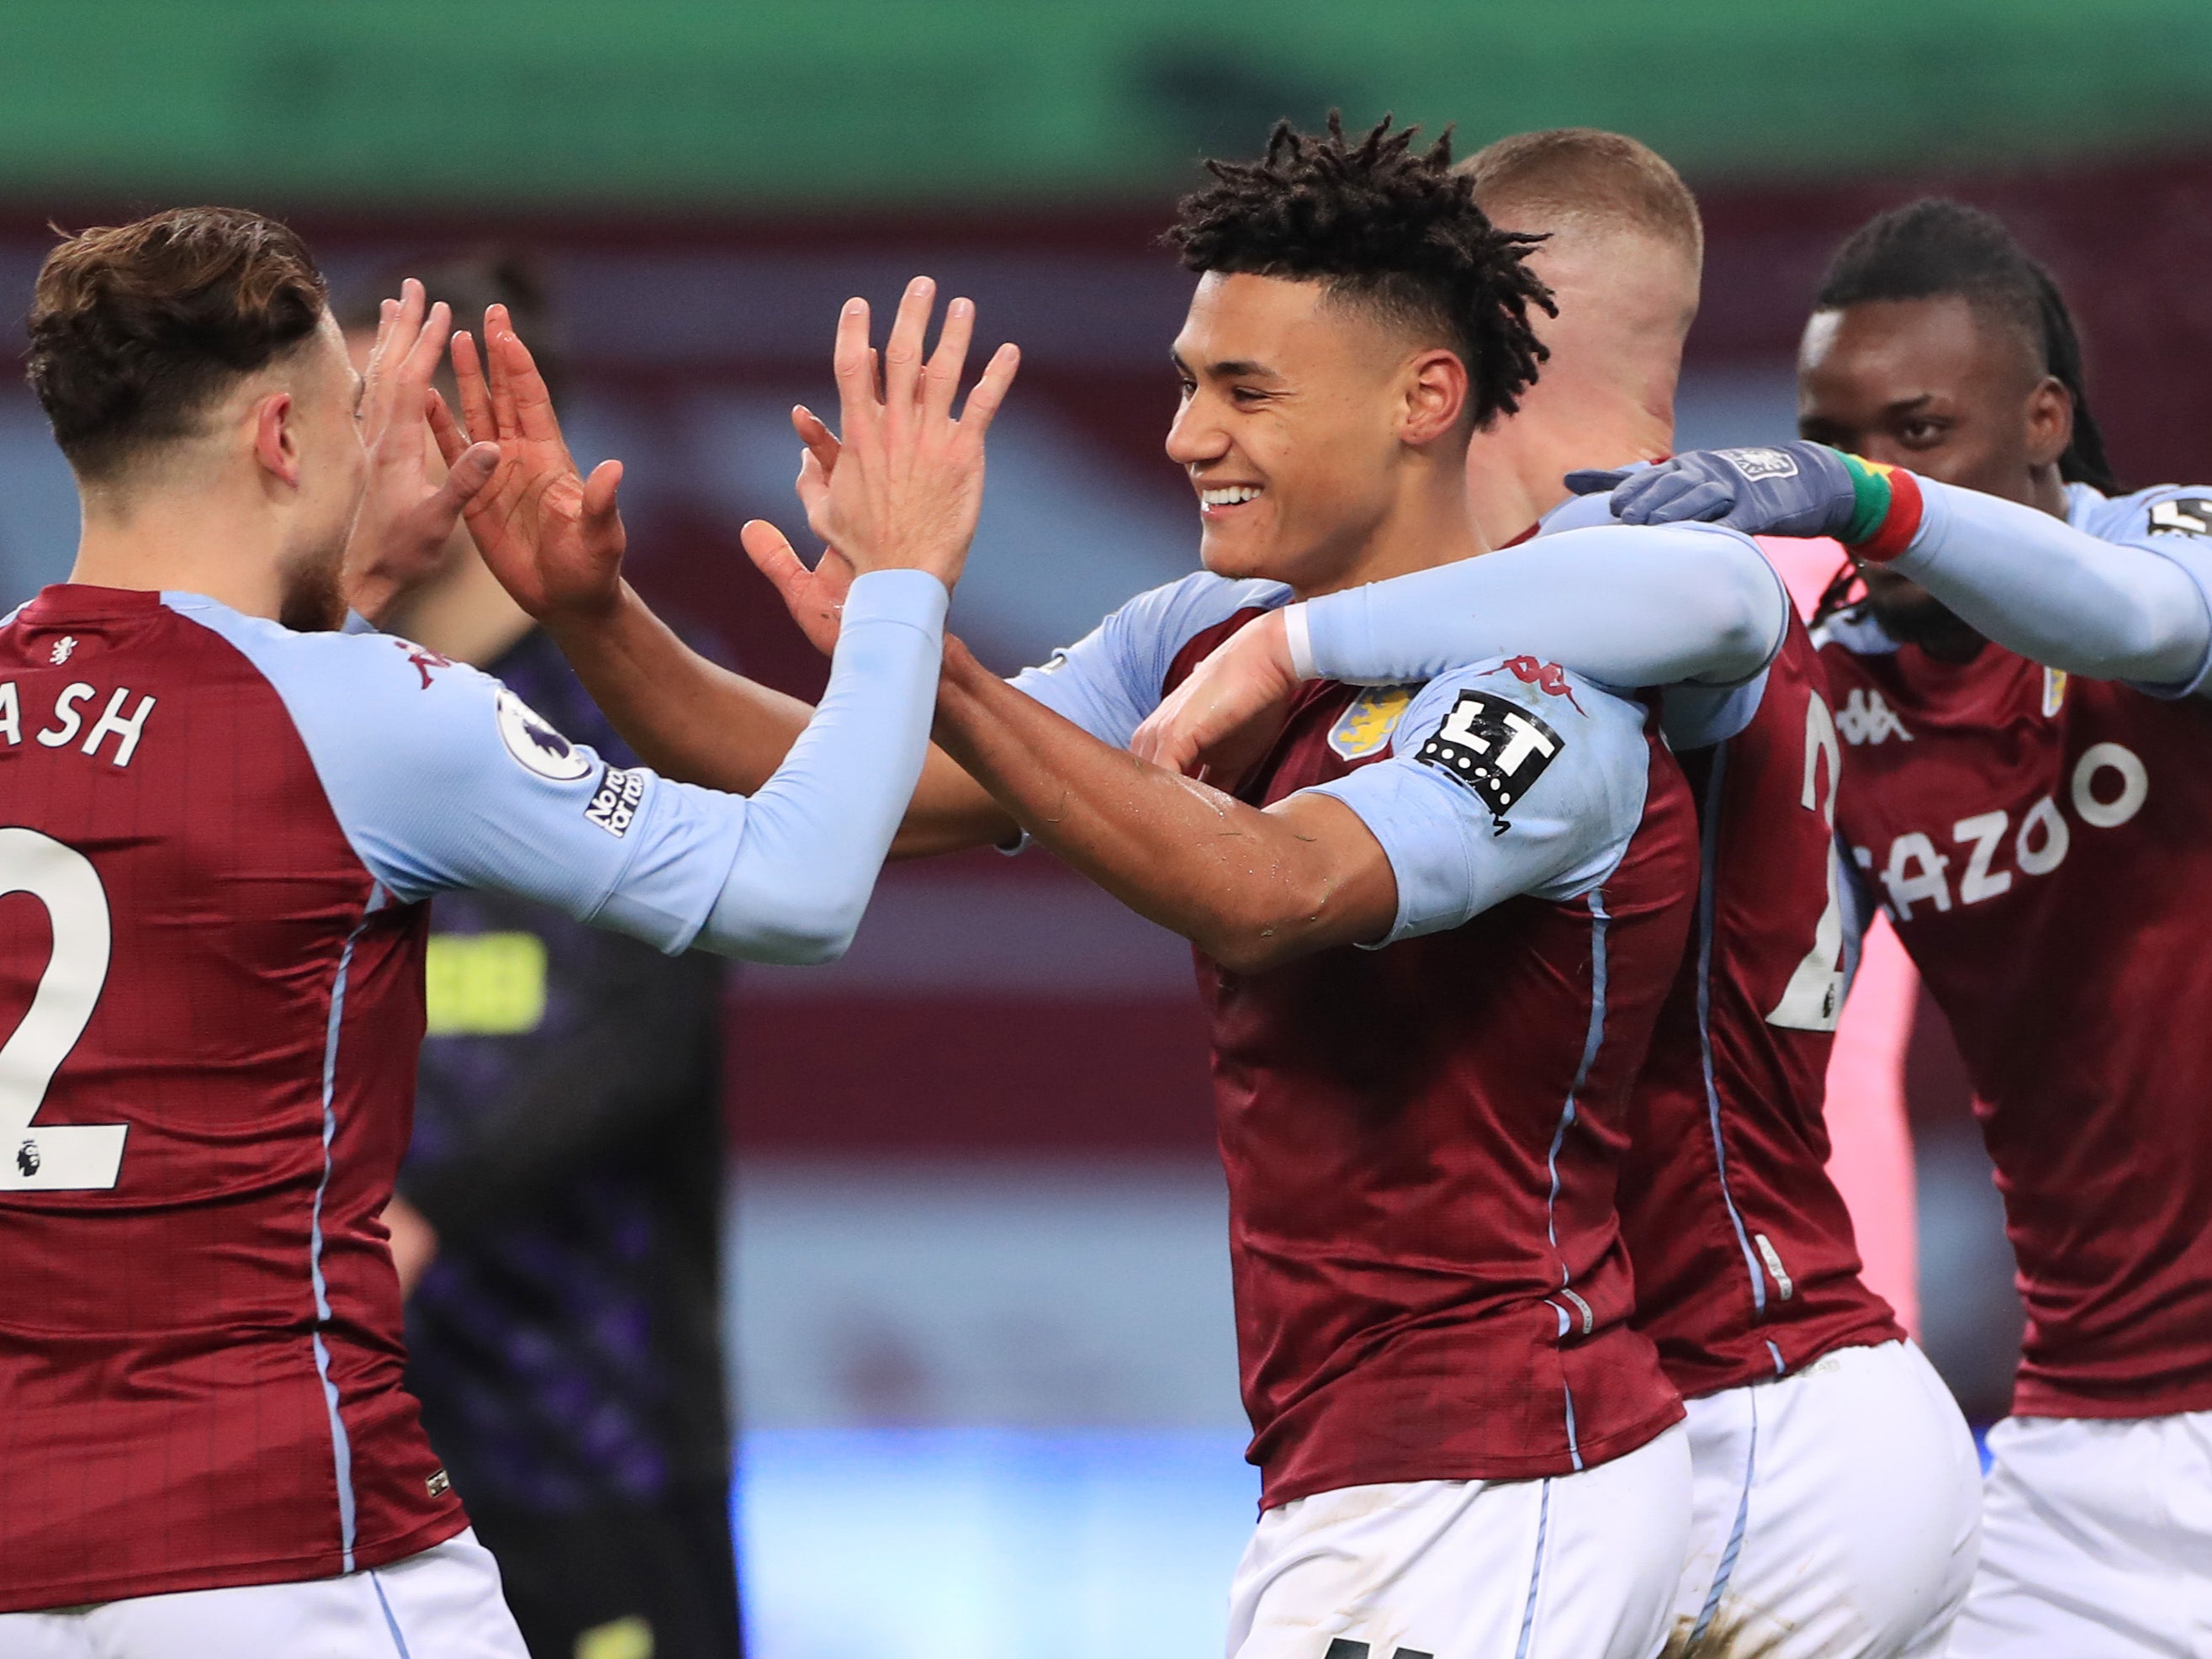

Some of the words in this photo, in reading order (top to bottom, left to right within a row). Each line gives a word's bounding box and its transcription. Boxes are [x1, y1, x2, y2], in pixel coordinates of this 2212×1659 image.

[1439, 699, 1556, 777] LT
[584, 789, 617, 827] No
[1853, 742, 2148, 923] AZOO
[0, 825, 130, 1191] 2
